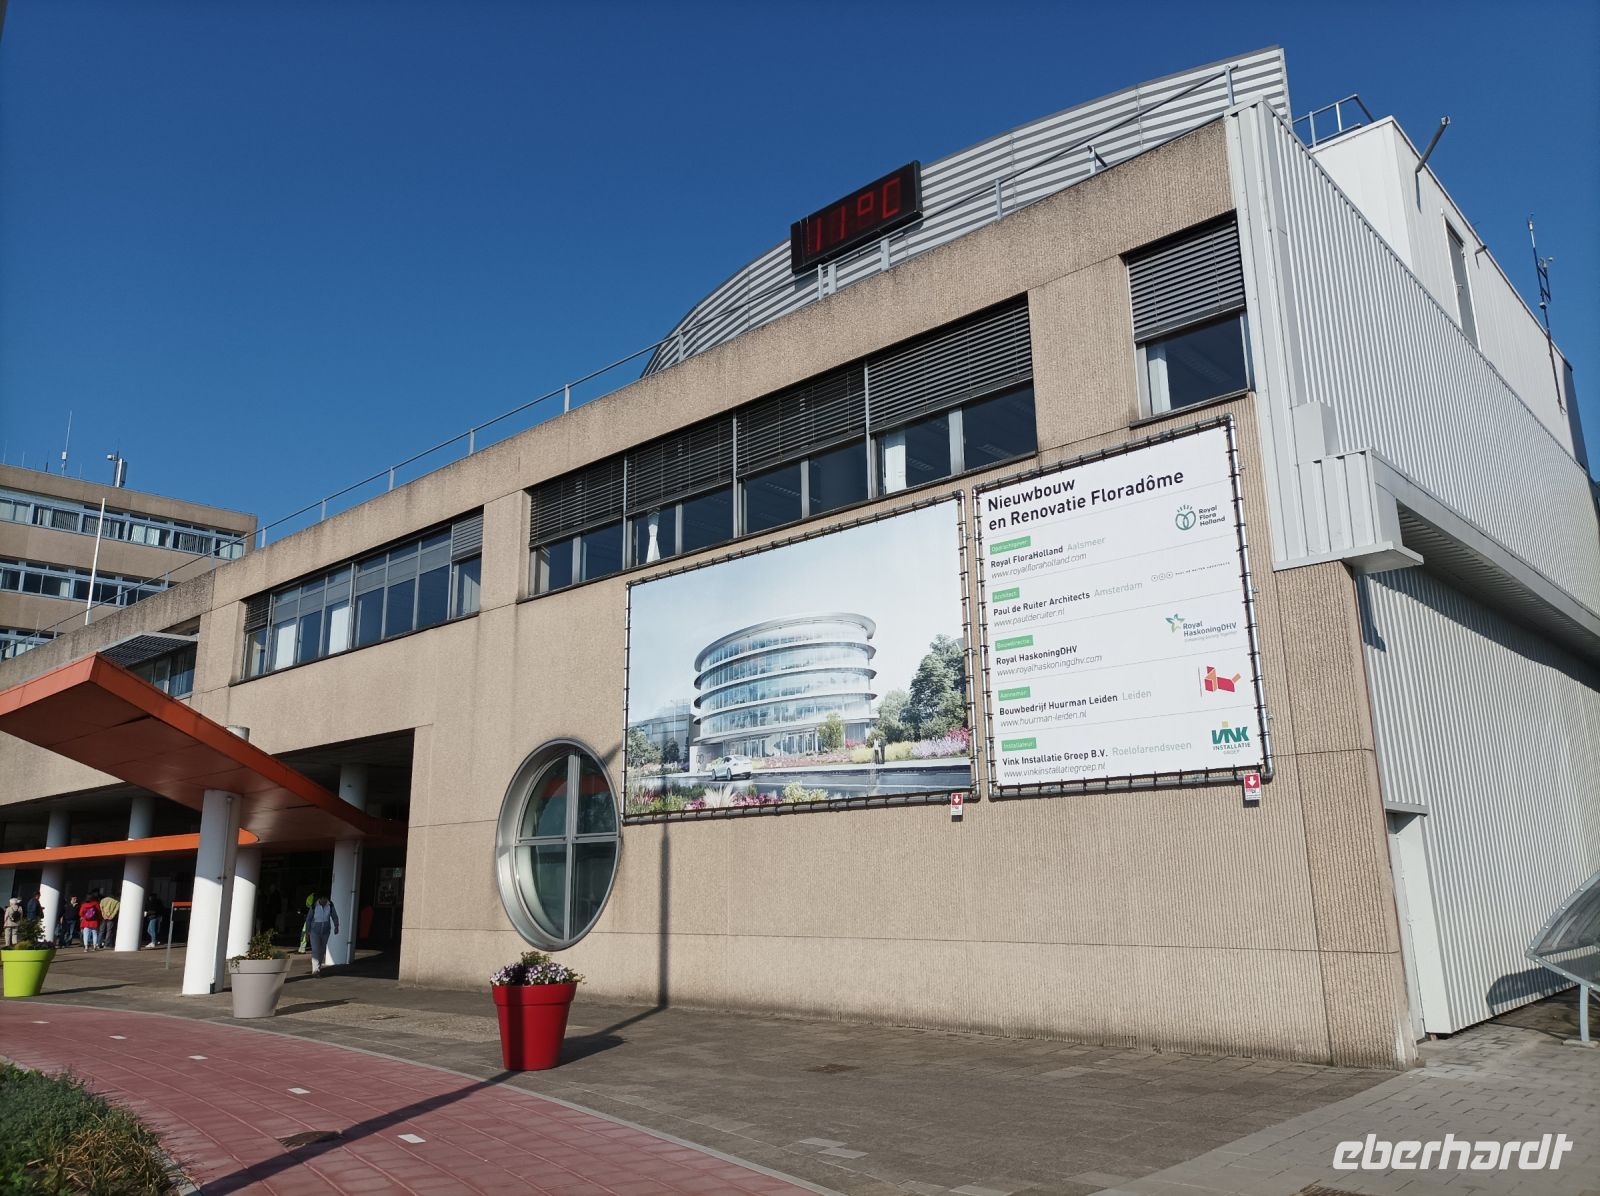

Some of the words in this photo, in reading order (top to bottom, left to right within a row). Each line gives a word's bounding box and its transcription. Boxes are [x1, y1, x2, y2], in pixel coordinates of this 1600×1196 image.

[988, 479, 1075, 511] Nieuwbouw
[989, 517, 1006, 531] en
[1010, 496, 1086, 525] Renovatie
[1091, 471, 1184, 505] Floradôme
[1199, 505, 1217, 514] Royal
[1200, 516, 1225, 526] Holland
[991, 557, 1011, 569] Royal
[1013, 545, 1063, 563] FloraHolland
[1067, 537, 1105, 551] Aalsmeer
[991, 553, 1087, 579] www.royalfloraholland.com
[993, 606, 1010, 616] Paul
[1012, 604, 1021, 613] de
[1023, 600, 1047, 611] Ruiter
[1049, 592, 1090, 606] Architects
[1094, 583, 1143, 597] Amsterdam
[993, 608, 1065, 627] www.paulderuiter.nl
[1183, 621, 1202, 630] Royal
[1183, 622, 1237, 637] HaskoningDHV
[996, 655, 1017, 666] Royal
[1019, 645, 1078, 661] HaskoningDHV
[996, 655, 1103, 677] www.royalhaskoningdhv.com
[1000, 702, 1046, 716] Bouwbedrijf
[1048, 699, 1086, 710] Huurman
[1089, 694, 1118, 705] Leiden
[1122, 689, 1151, 701] Leiden
[1000, 710, 1087, 727] www.huurman-leiden.nl
[1002, 755, 1020, 766] Vink
[1021, 752, 1062, 764] Installatie
[1064, 751, 1089, 762] Groep
[1091, 749, 1108, 758] B.V.
[1112, 742, 1192, 756] Roelofarendsveen
[1213, 742, 1251, 751] INSTALLATIE
[1003, 763, 1106, 778] www.vinkinstallatiegroep.nl
